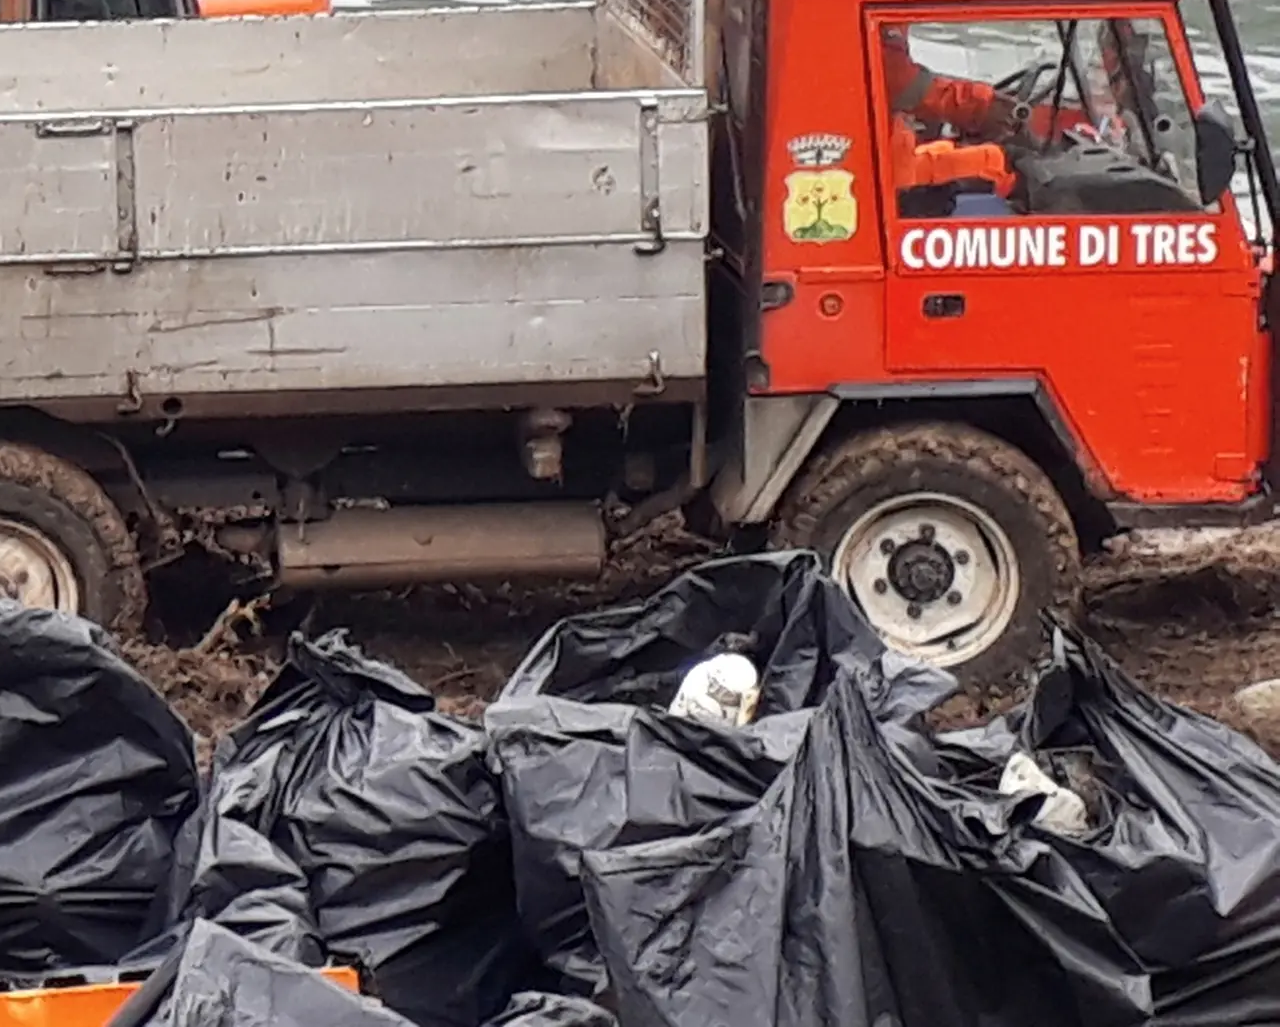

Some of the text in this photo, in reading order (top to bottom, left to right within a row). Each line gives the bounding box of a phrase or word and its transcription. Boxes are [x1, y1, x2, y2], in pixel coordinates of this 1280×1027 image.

[900, 222, 1218, 270] COMUNE DI TRES
